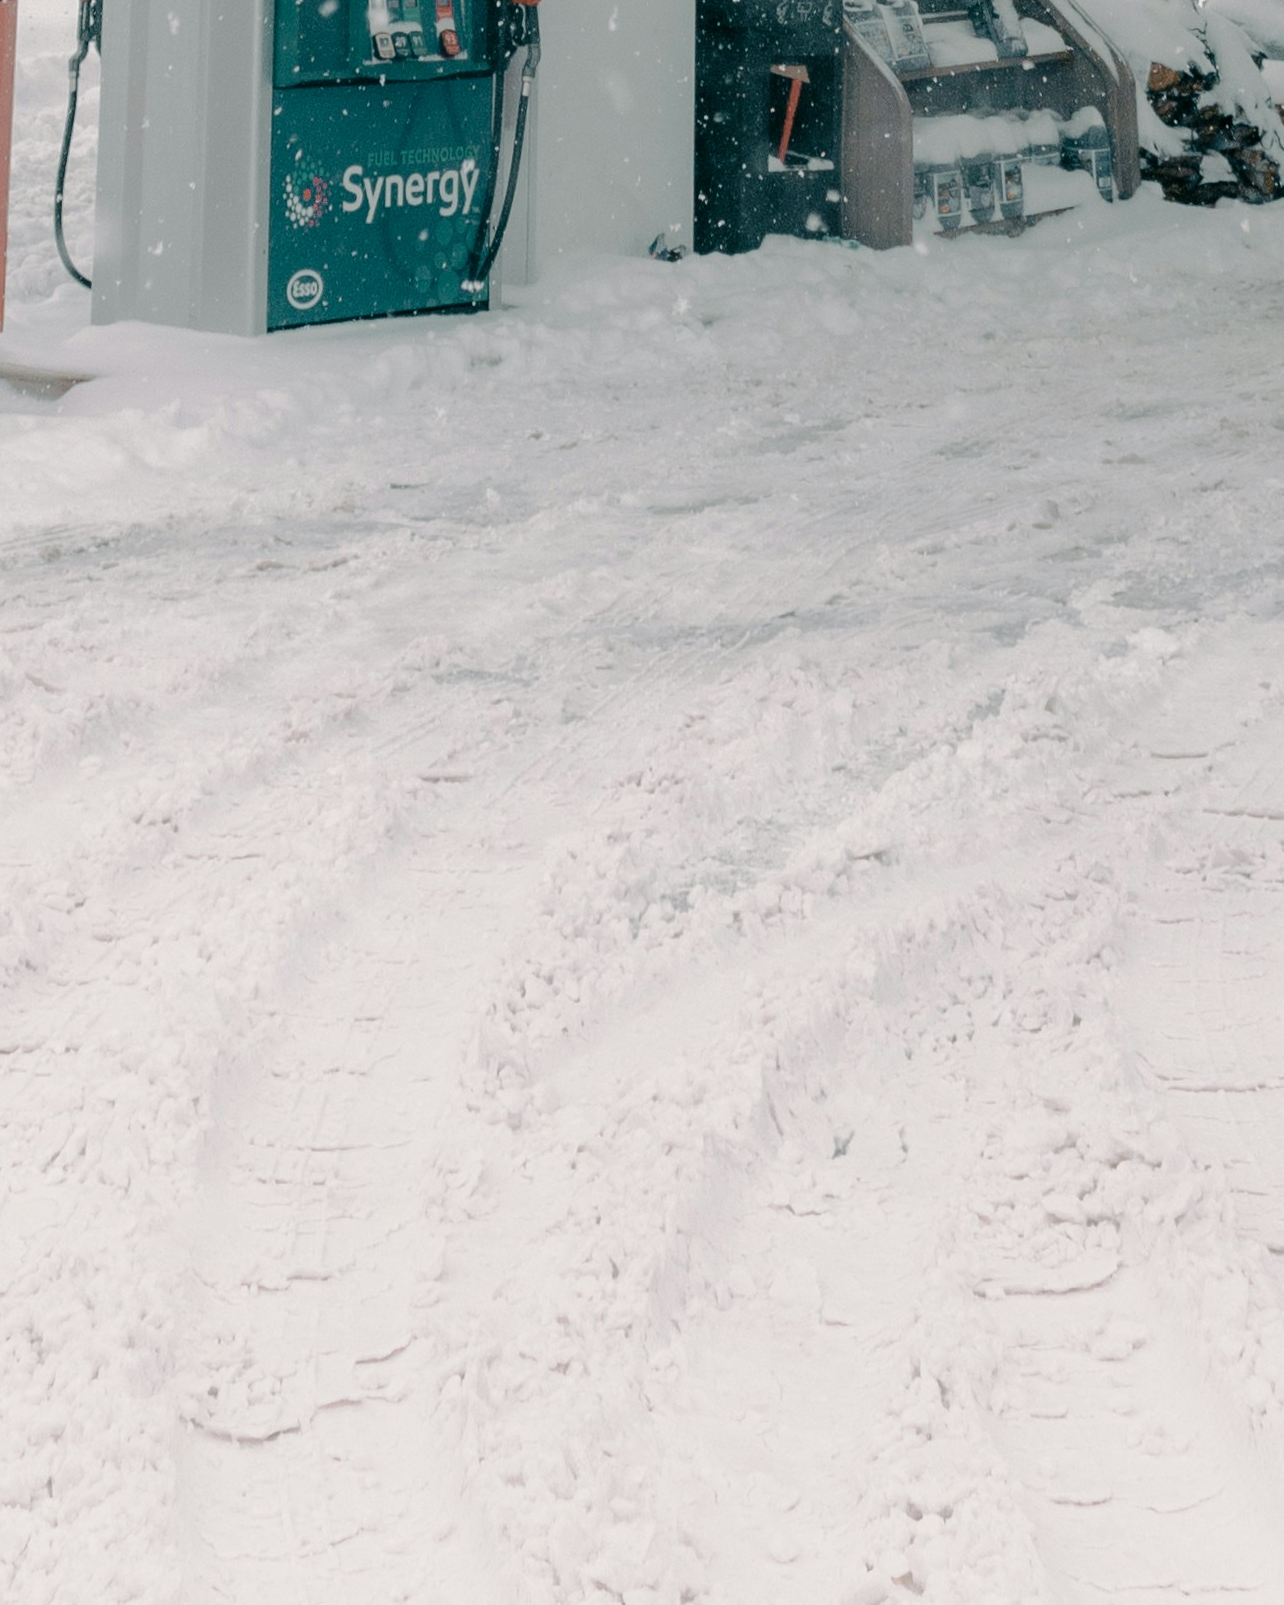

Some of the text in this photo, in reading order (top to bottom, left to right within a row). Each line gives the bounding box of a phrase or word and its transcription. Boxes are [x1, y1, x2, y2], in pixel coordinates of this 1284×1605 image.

[367, 144, 482, 169] FUEL TECHNOLOGY
[342, 164, 481, 224] Synergy
[292, 280, 317, 298] Esso
